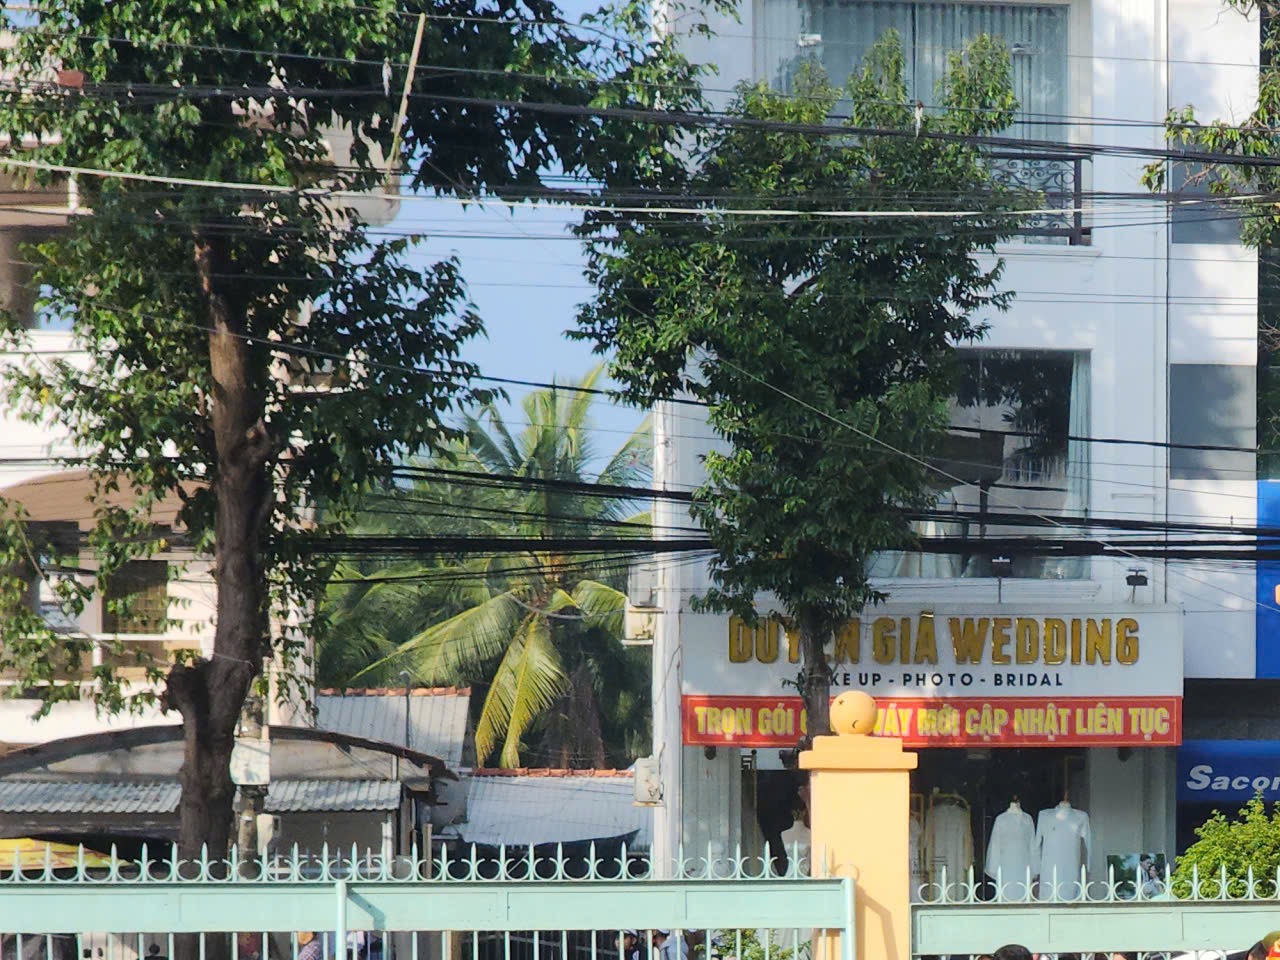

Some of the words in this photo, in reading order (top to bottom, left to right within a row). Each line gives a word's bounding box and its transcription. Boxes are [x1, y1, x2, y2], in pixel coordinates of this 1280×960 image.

[728, 614, 861, 664] DUYN
[948, 617, 1140, 665] WEDDING
[859, 672, 882, 687] UP
[903, 672, 974, 687] PHOTO
[993, 672, 1063, 687] BRIDAL
[695, 706, 753, 740] TRỌN
[758, 702, 795, 735] GÓI
[917, 703, 960, 736] MỚI
[965, 703, 1009, 741] CẬP
[1014, 702, 1071, 741] NHẬT
[1075, 702, 1124, 735] LIÊN
[1128, 707, 1170, 741] TỤC
